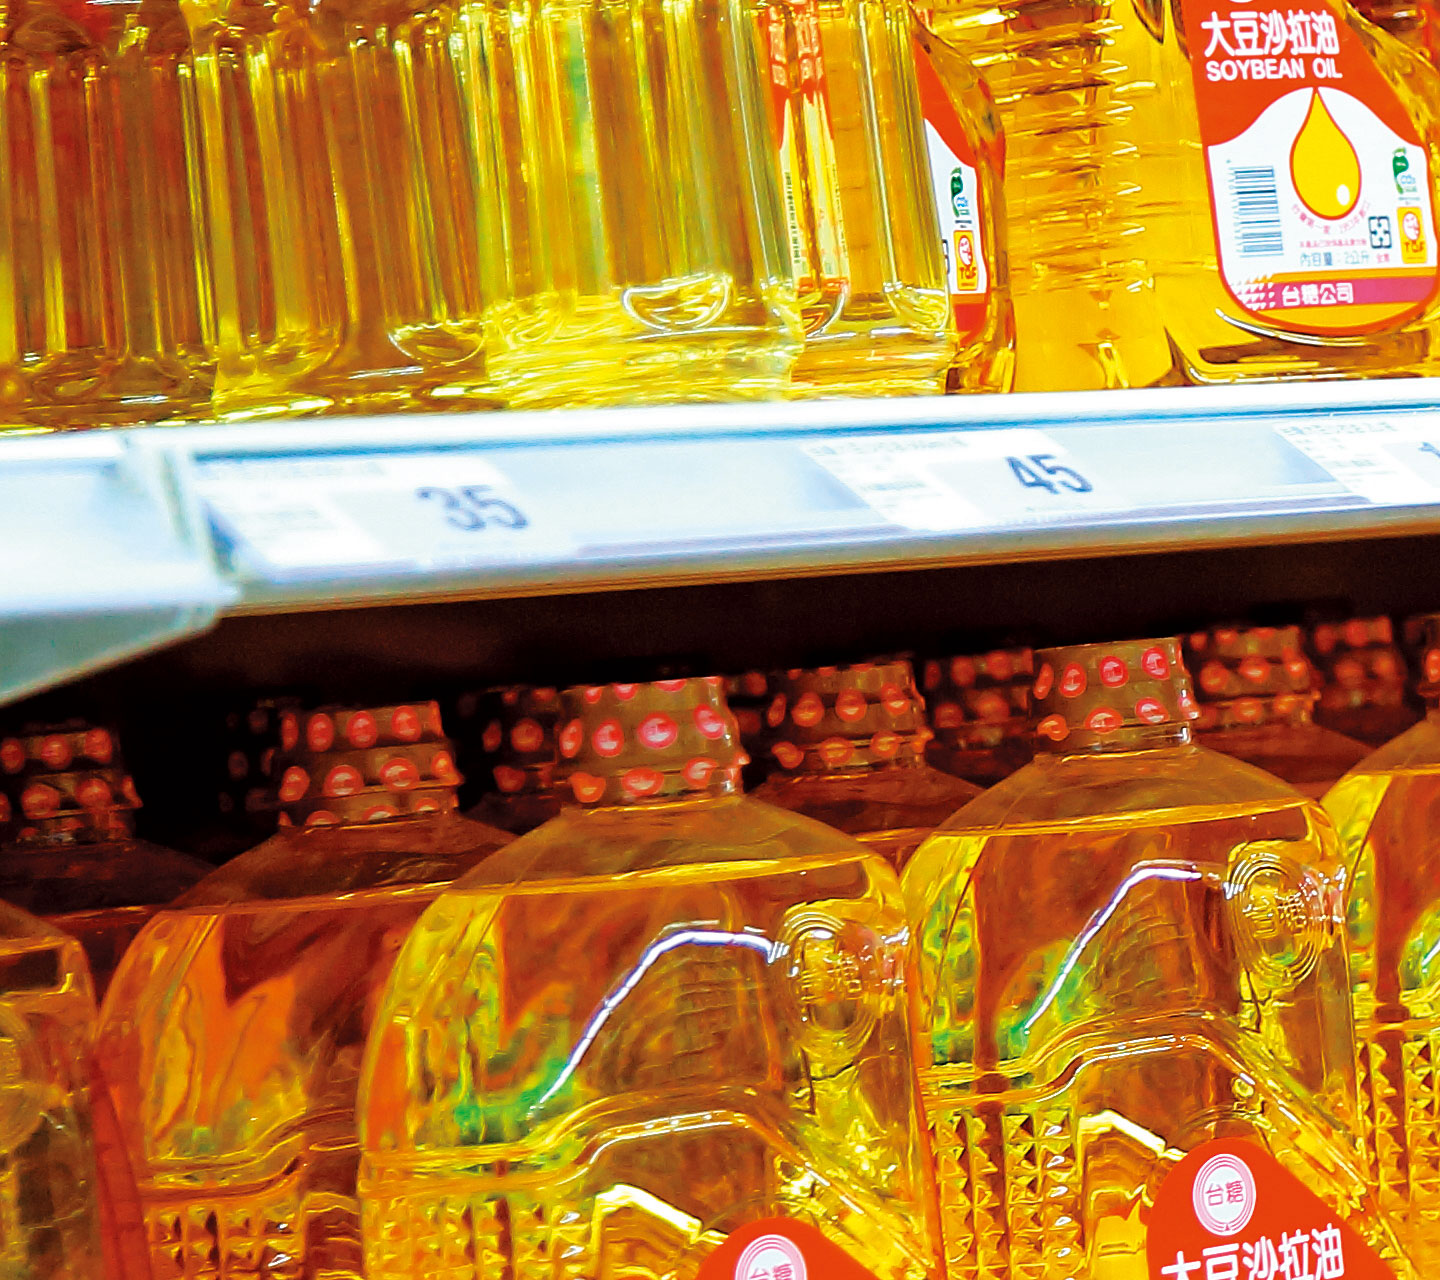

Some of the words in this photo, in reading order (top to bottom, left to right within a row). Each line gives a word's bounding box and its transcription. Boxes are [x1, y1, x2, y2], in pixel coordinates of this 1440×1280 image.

[1201, 9, 1340, 58] 大豆沙拉油
[1206, 58, 1305, 82] SOYBEAN
[1314, 57, 1343, 79] OIL
[1282, 282, 1354, 308] 台糖公司
[1005, 453, 1094, 496] 45
[415, 484, 530, 532] 35
[1204, 1179, 1244, 1208] 台糖
